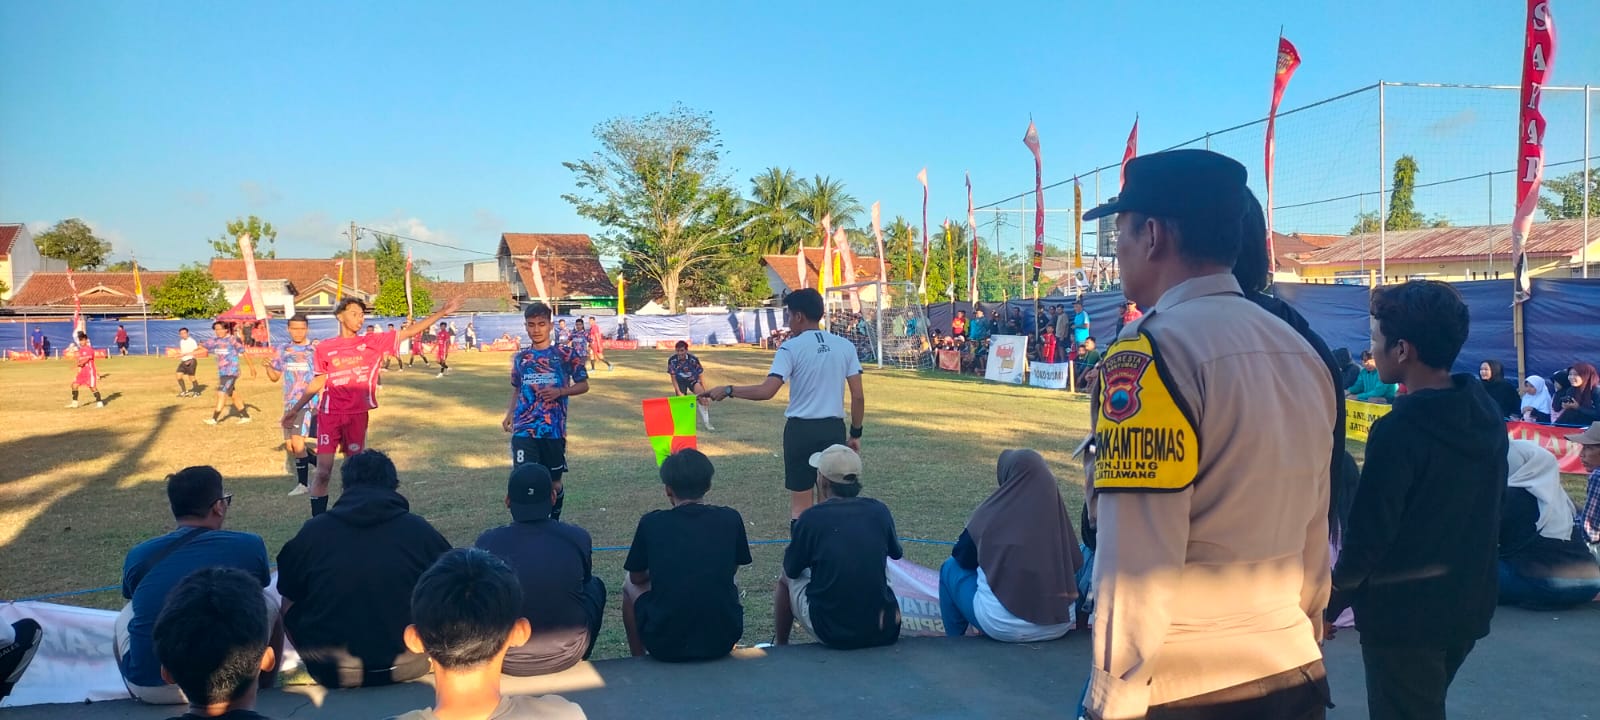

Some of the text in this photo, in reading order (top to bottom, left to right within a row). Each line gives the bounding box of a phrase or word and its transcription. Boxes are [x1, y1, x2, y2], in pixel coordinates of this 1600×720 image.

[1106, 355, 1141, 369] POLRESTA
[320, 434, 330, 445] 13
[516, 449, 525, 463] 8
